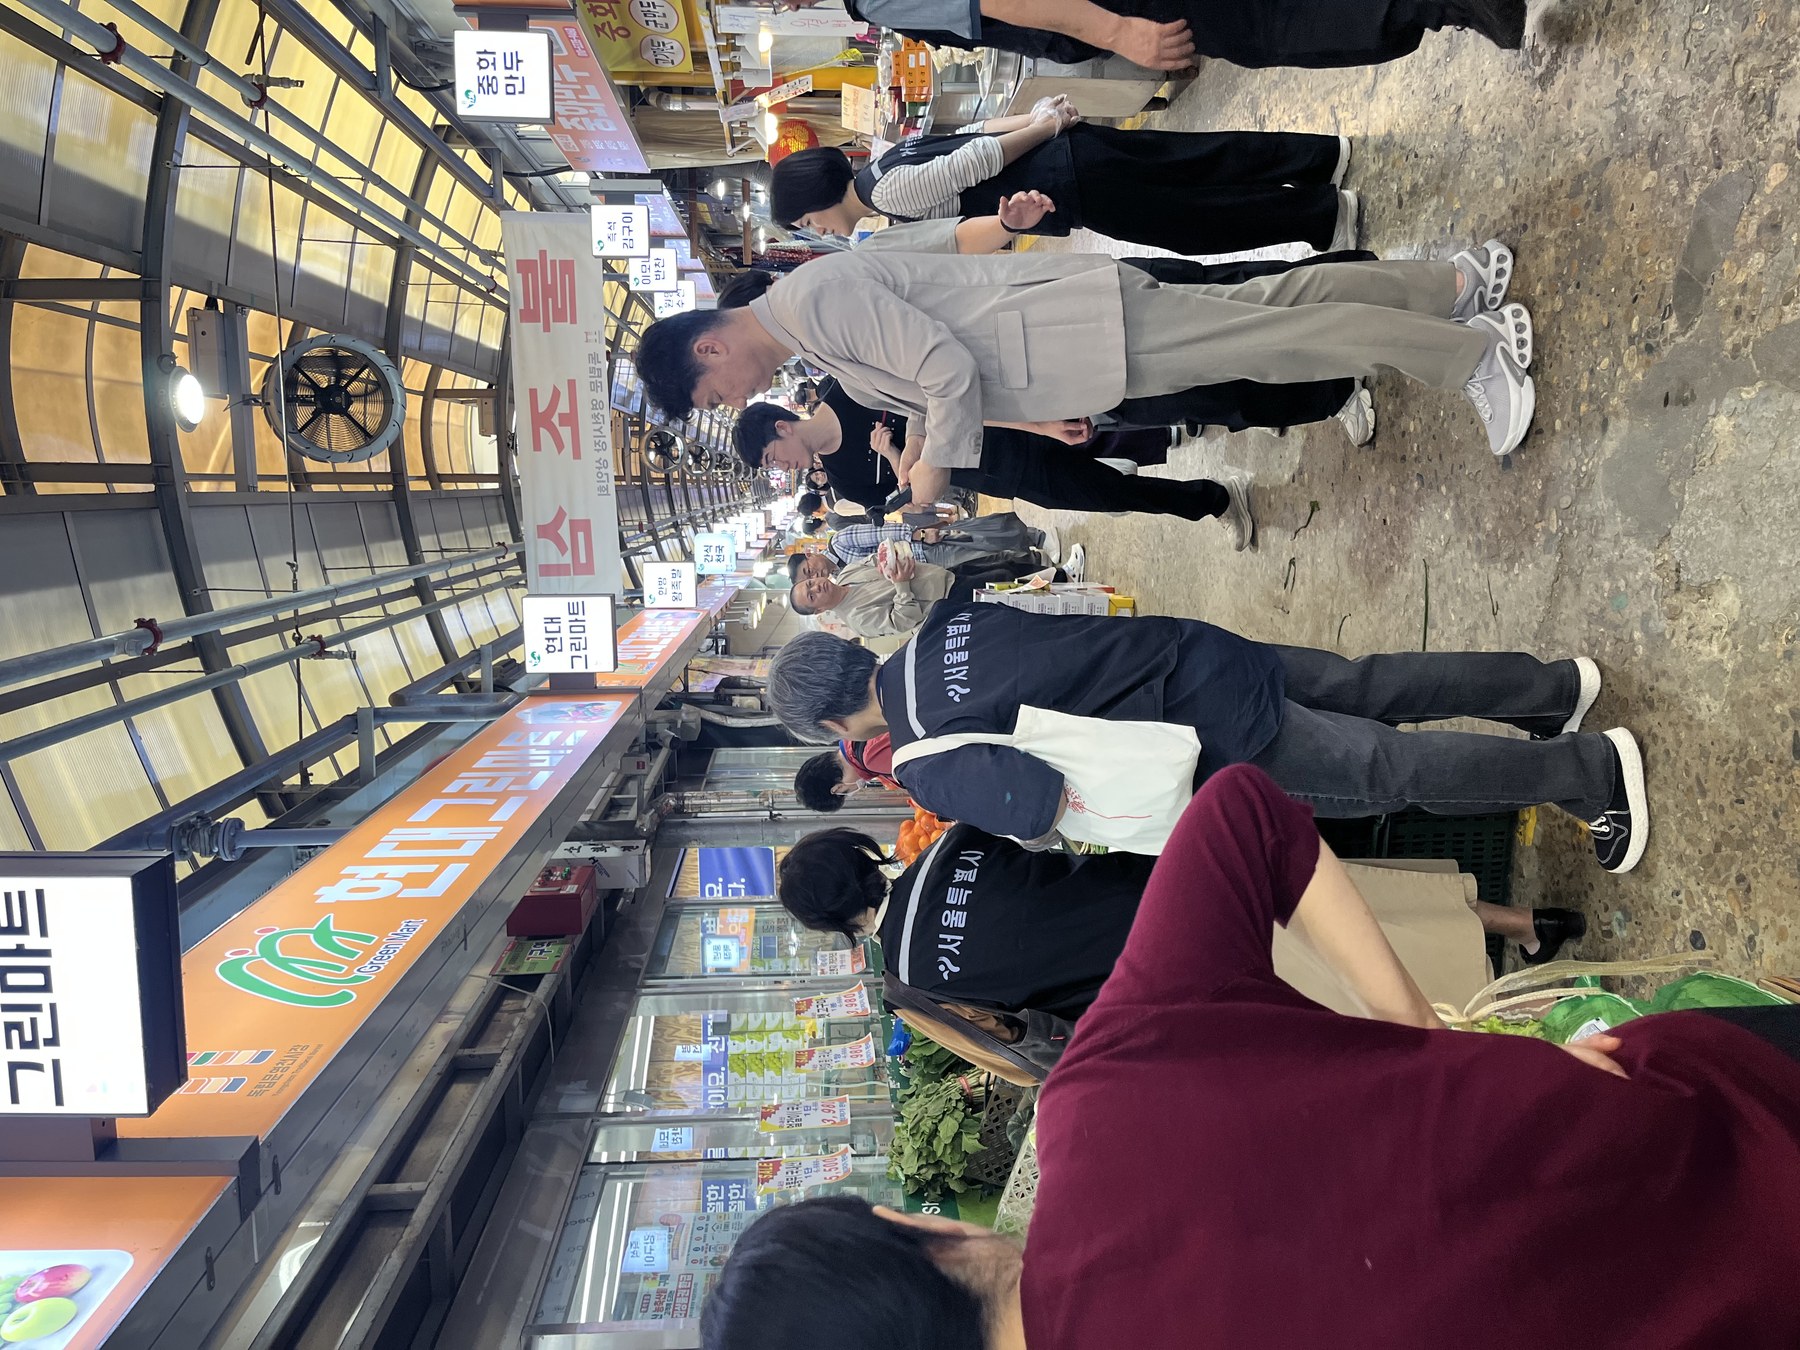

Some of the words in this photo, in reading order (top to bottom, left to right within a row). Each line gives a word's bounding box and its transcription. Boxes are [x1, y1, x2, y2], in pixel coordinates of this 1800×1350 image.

[476, 49, 498, 95] 중화
[503, 51, 525, 95] 만두
[607, 221, 617, 242] 즉석
[622, 212, 634, 249] 김구이
[654, 257, 665, 280] 반찬
[703, 545, 713, 563] 간식
[715, 545, 724, 563] 천국
[657, 577, 667, 596] 한방
[670, 568, 682, 602] 왕족발
[543, 617, 562, 654] 현대
[567, 600, 588, 670] 그린마트
[943, 612, 973, 681] 서울특별시
[314, 729, 588, 903] 현대그린마트
[937, 850, 984, 955] 서울특별시
[355, 943, 404, 974] Green
[384, 919, 425, 942] Mart
[0, 889, 64, 1106] 그린마트
[843, 993, 860, 1015] 3,980
[246, 1045, 310, 1097] 독립문영천시장
[849, 1044, 865, 1066] 2,980
[758, 1162, 773, 1179] SALE
[823, 1157, 840, 1181] 5,500
